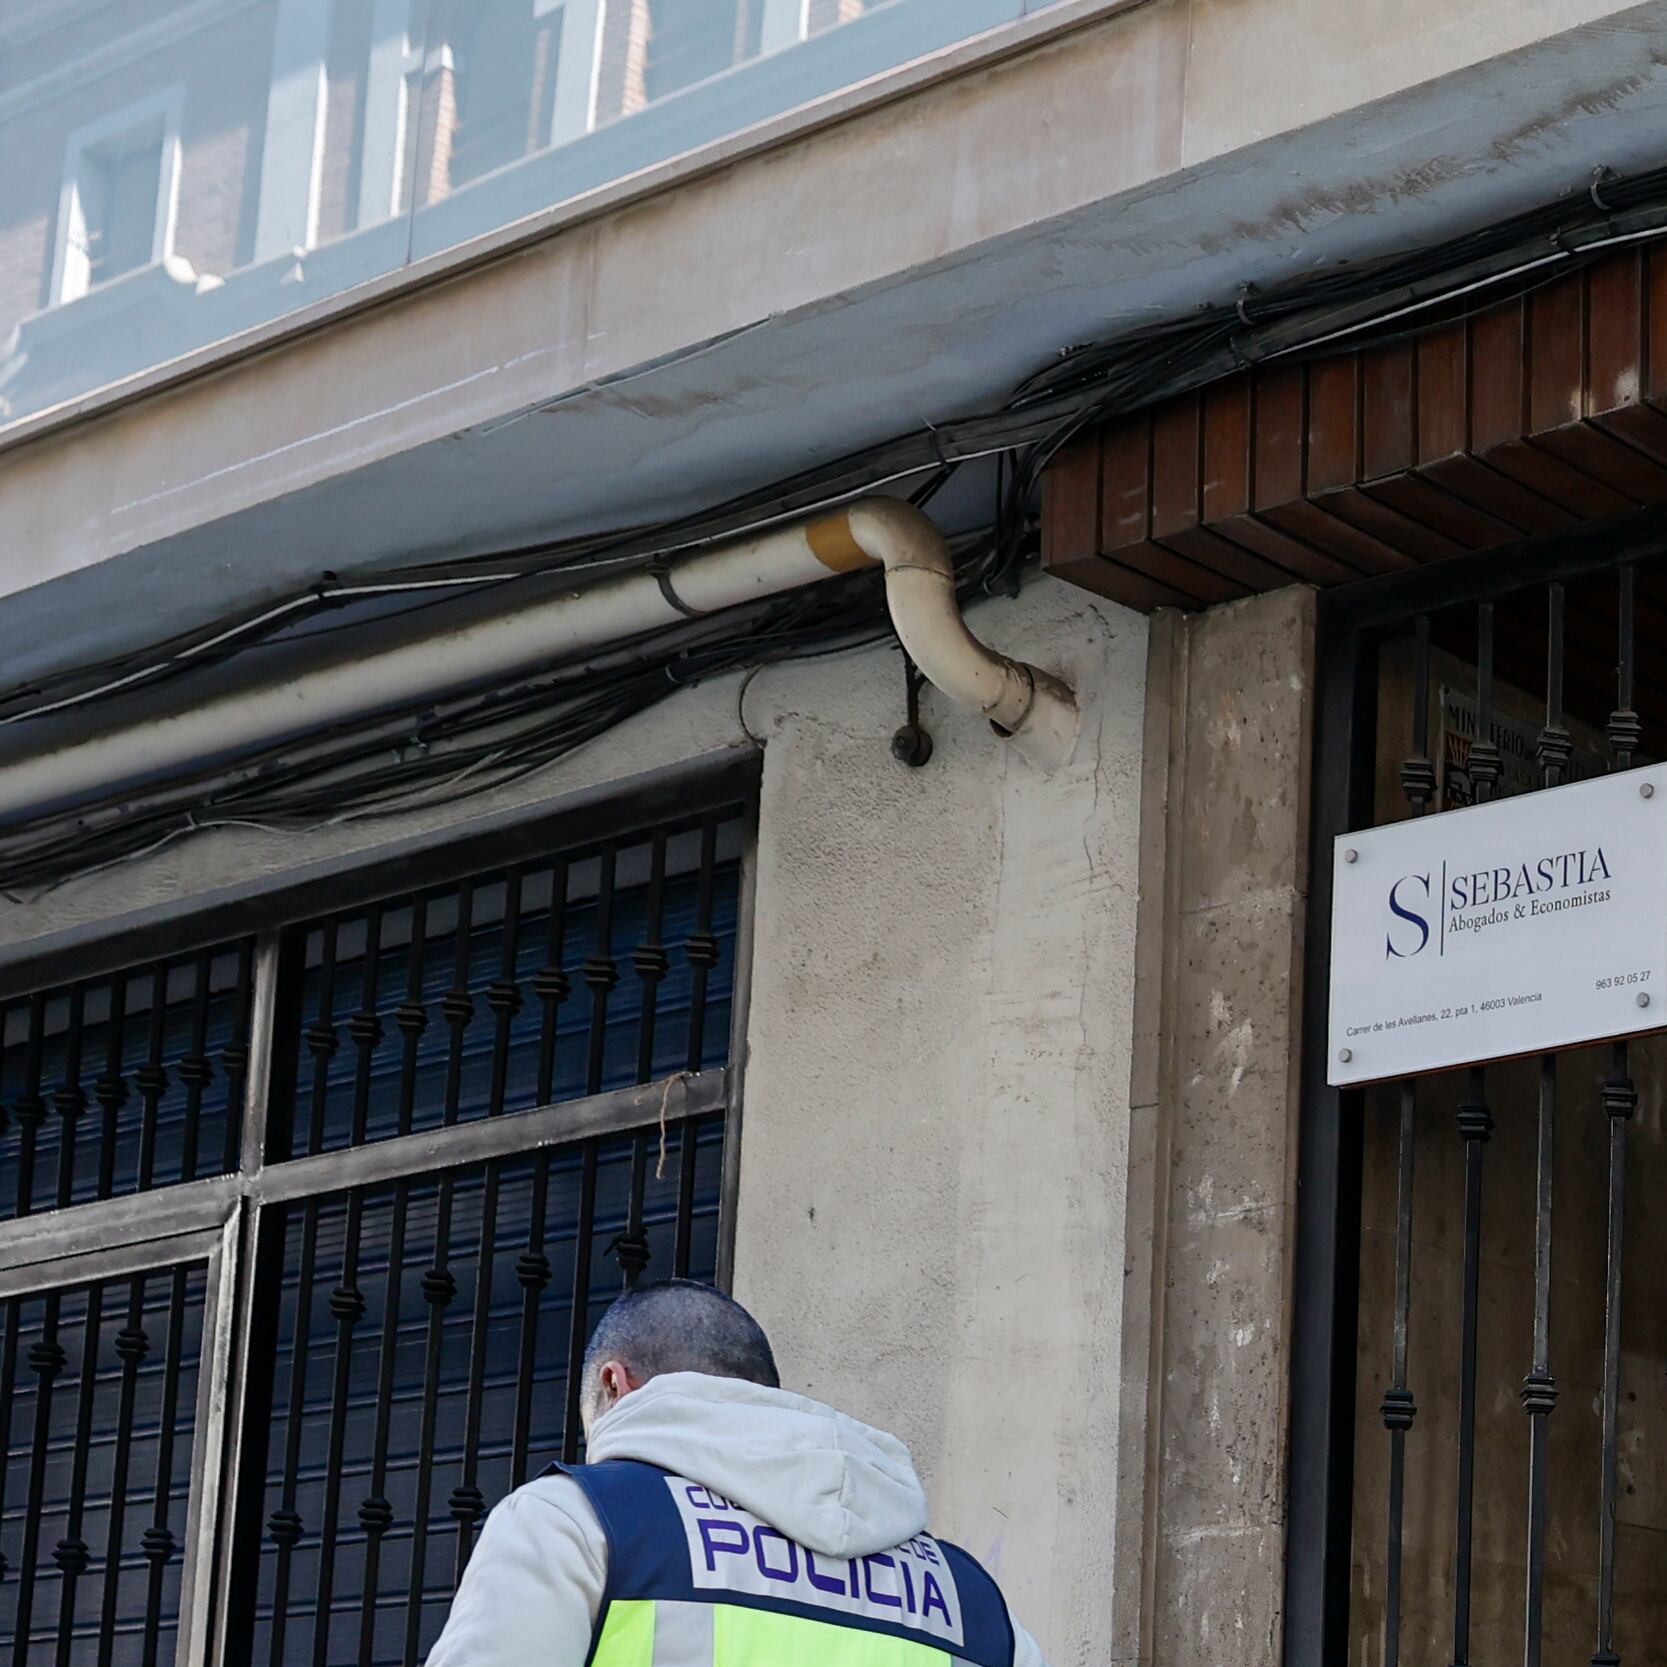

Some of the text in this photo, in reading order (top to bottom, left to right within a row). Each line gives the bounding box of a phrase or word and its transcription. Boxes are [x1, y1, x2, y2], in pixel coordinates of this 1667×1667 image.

[1450, 847, 1612, 911] SEBASTIA
[1386, 874, 1430, 960] S
[1449, 887, 1611, 933] Abogados & Economistas
[1596, 970, 1651, 990] 963 92 05 27
[1346, 1024, 1371, 1038] Carrer
[1373, 1021, 1383, 1032] de
[1385, 1019, 1396, 1030] les
[1480, 999, 1506, 1012] 46003
[1507, 992, 1542, 1008] Valencia
[697, 1518, 952, 1627] POLICIA
